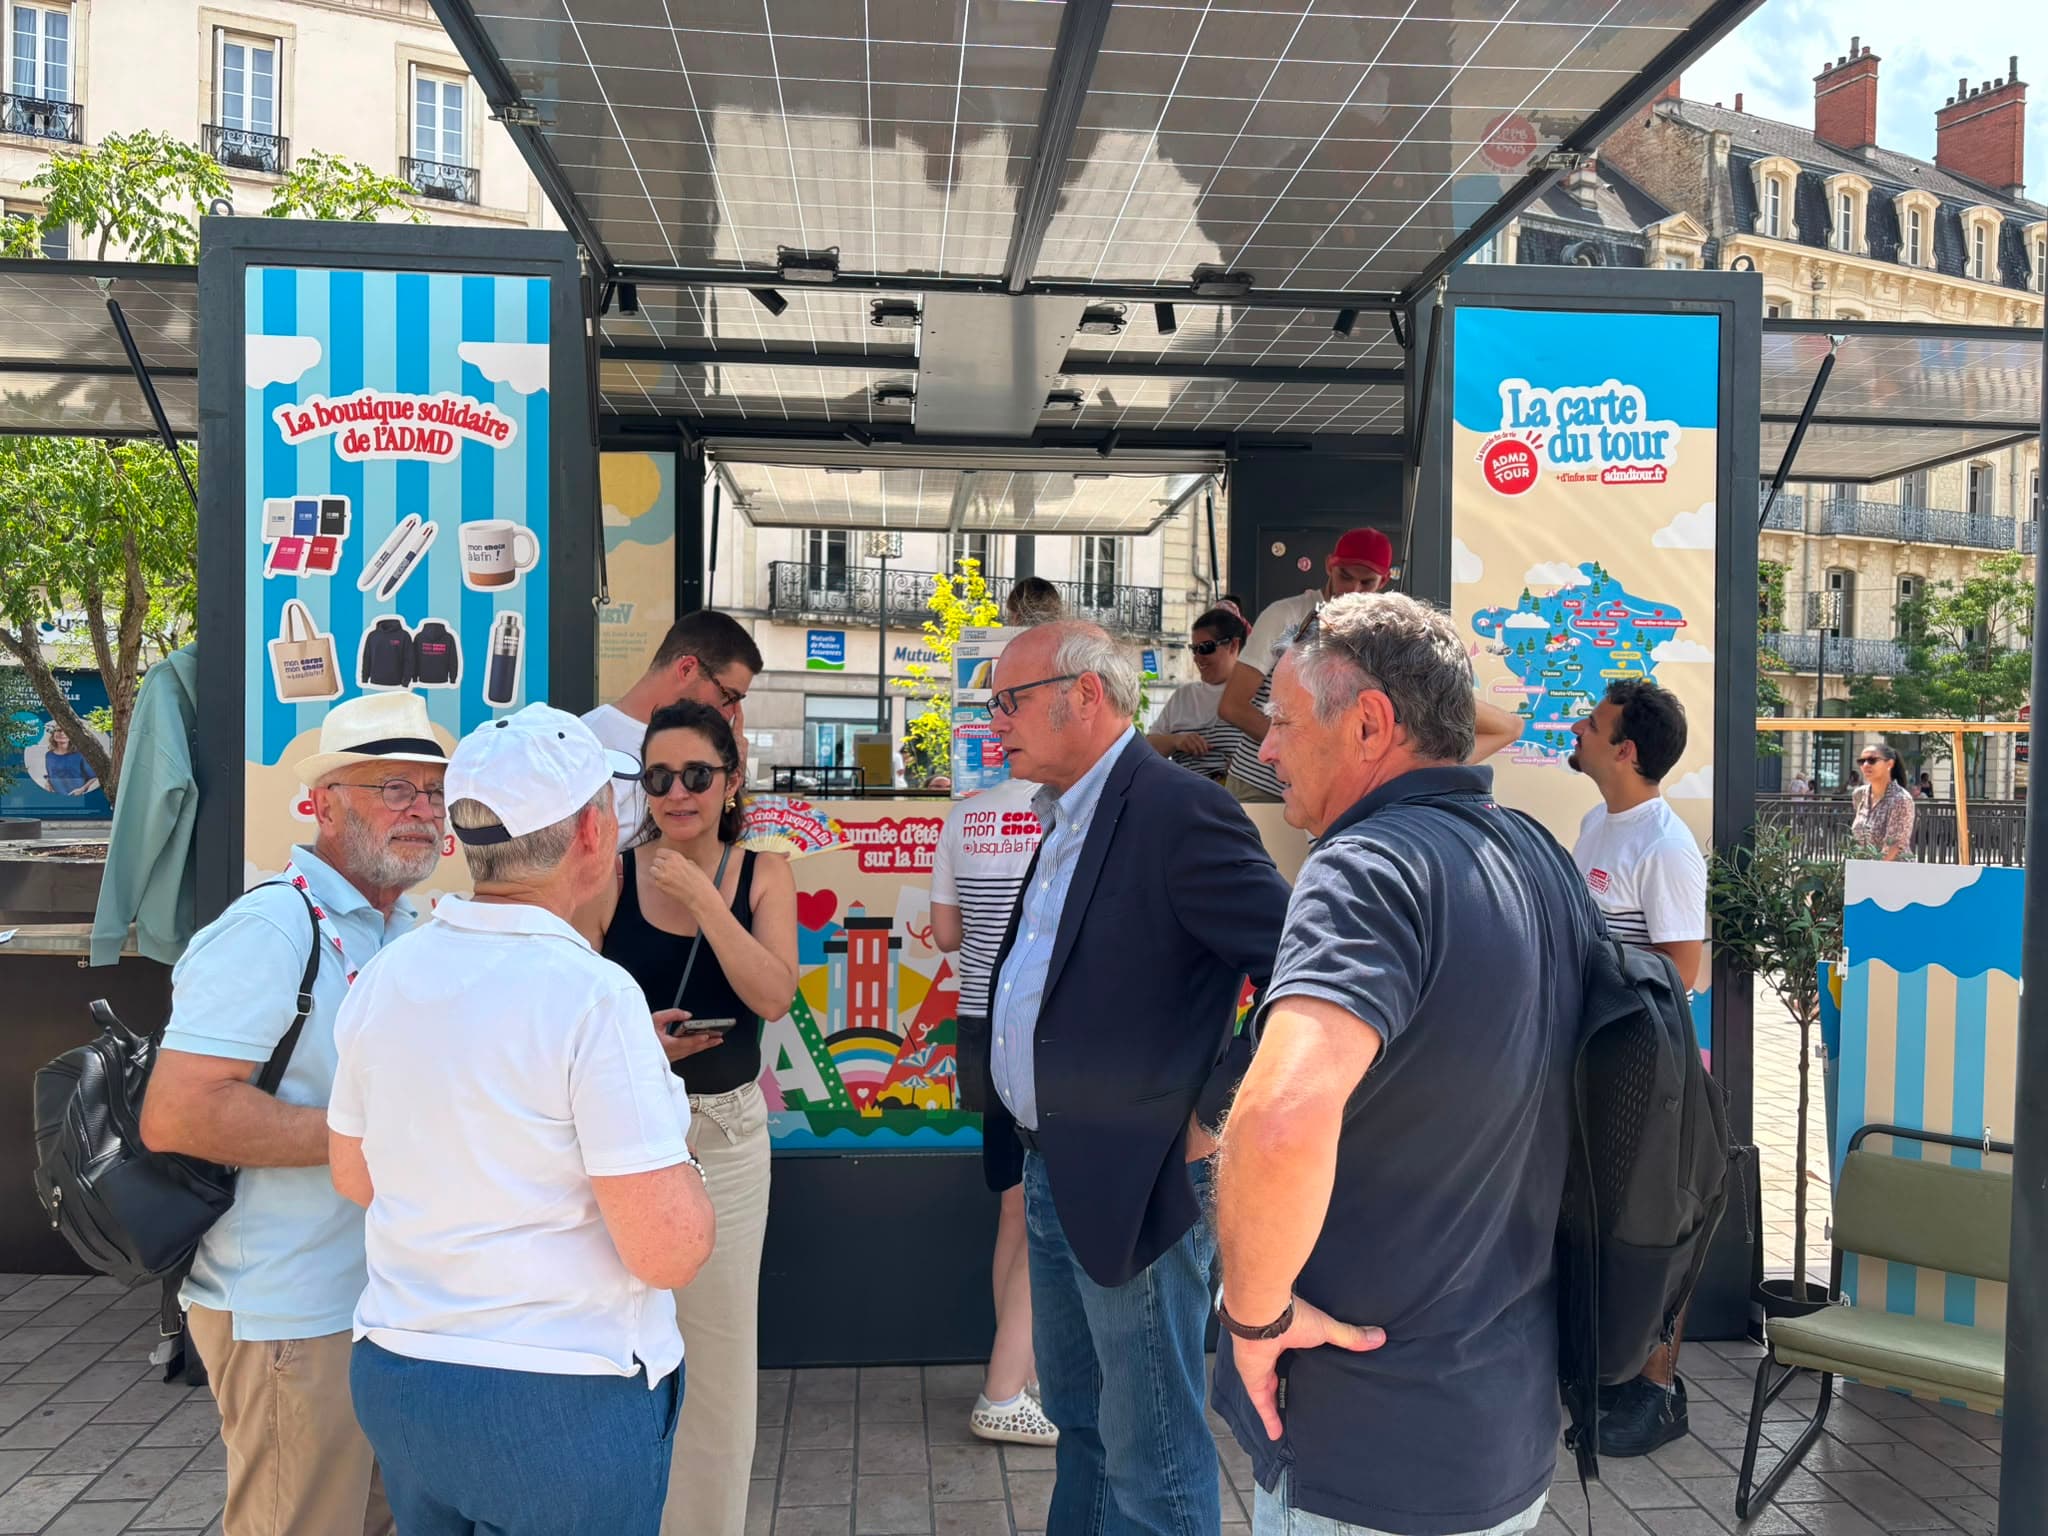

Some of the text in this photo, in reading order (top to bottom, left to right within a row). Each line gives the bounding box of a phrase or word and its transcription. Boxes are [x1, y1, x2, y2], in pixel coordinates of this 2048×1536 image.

[1508, 389, 1638, 428] La carte
[281, 396, 510, 442] La boutique solidaire
[343, 426, 454, 456] de l'ADMD
[1548, 426, 1670, 463] du tour
[1492, 452, 1528, 470] ADMD
[1496, 468, 1530, 484] TOUR
[1604, 467, 1664, 481] admdtour.fr
[964, 811, 1038, 824] mon cor
[845, 823, 938, 844] urnée d'été
[963, 823, 1042, 838] mon choi
[864, 851, 893, 867] sur
[894, 847, 912, 867] la
[971, 839, 1012, 857] jusqu'à
[1014, 838, 1023, 853] la
